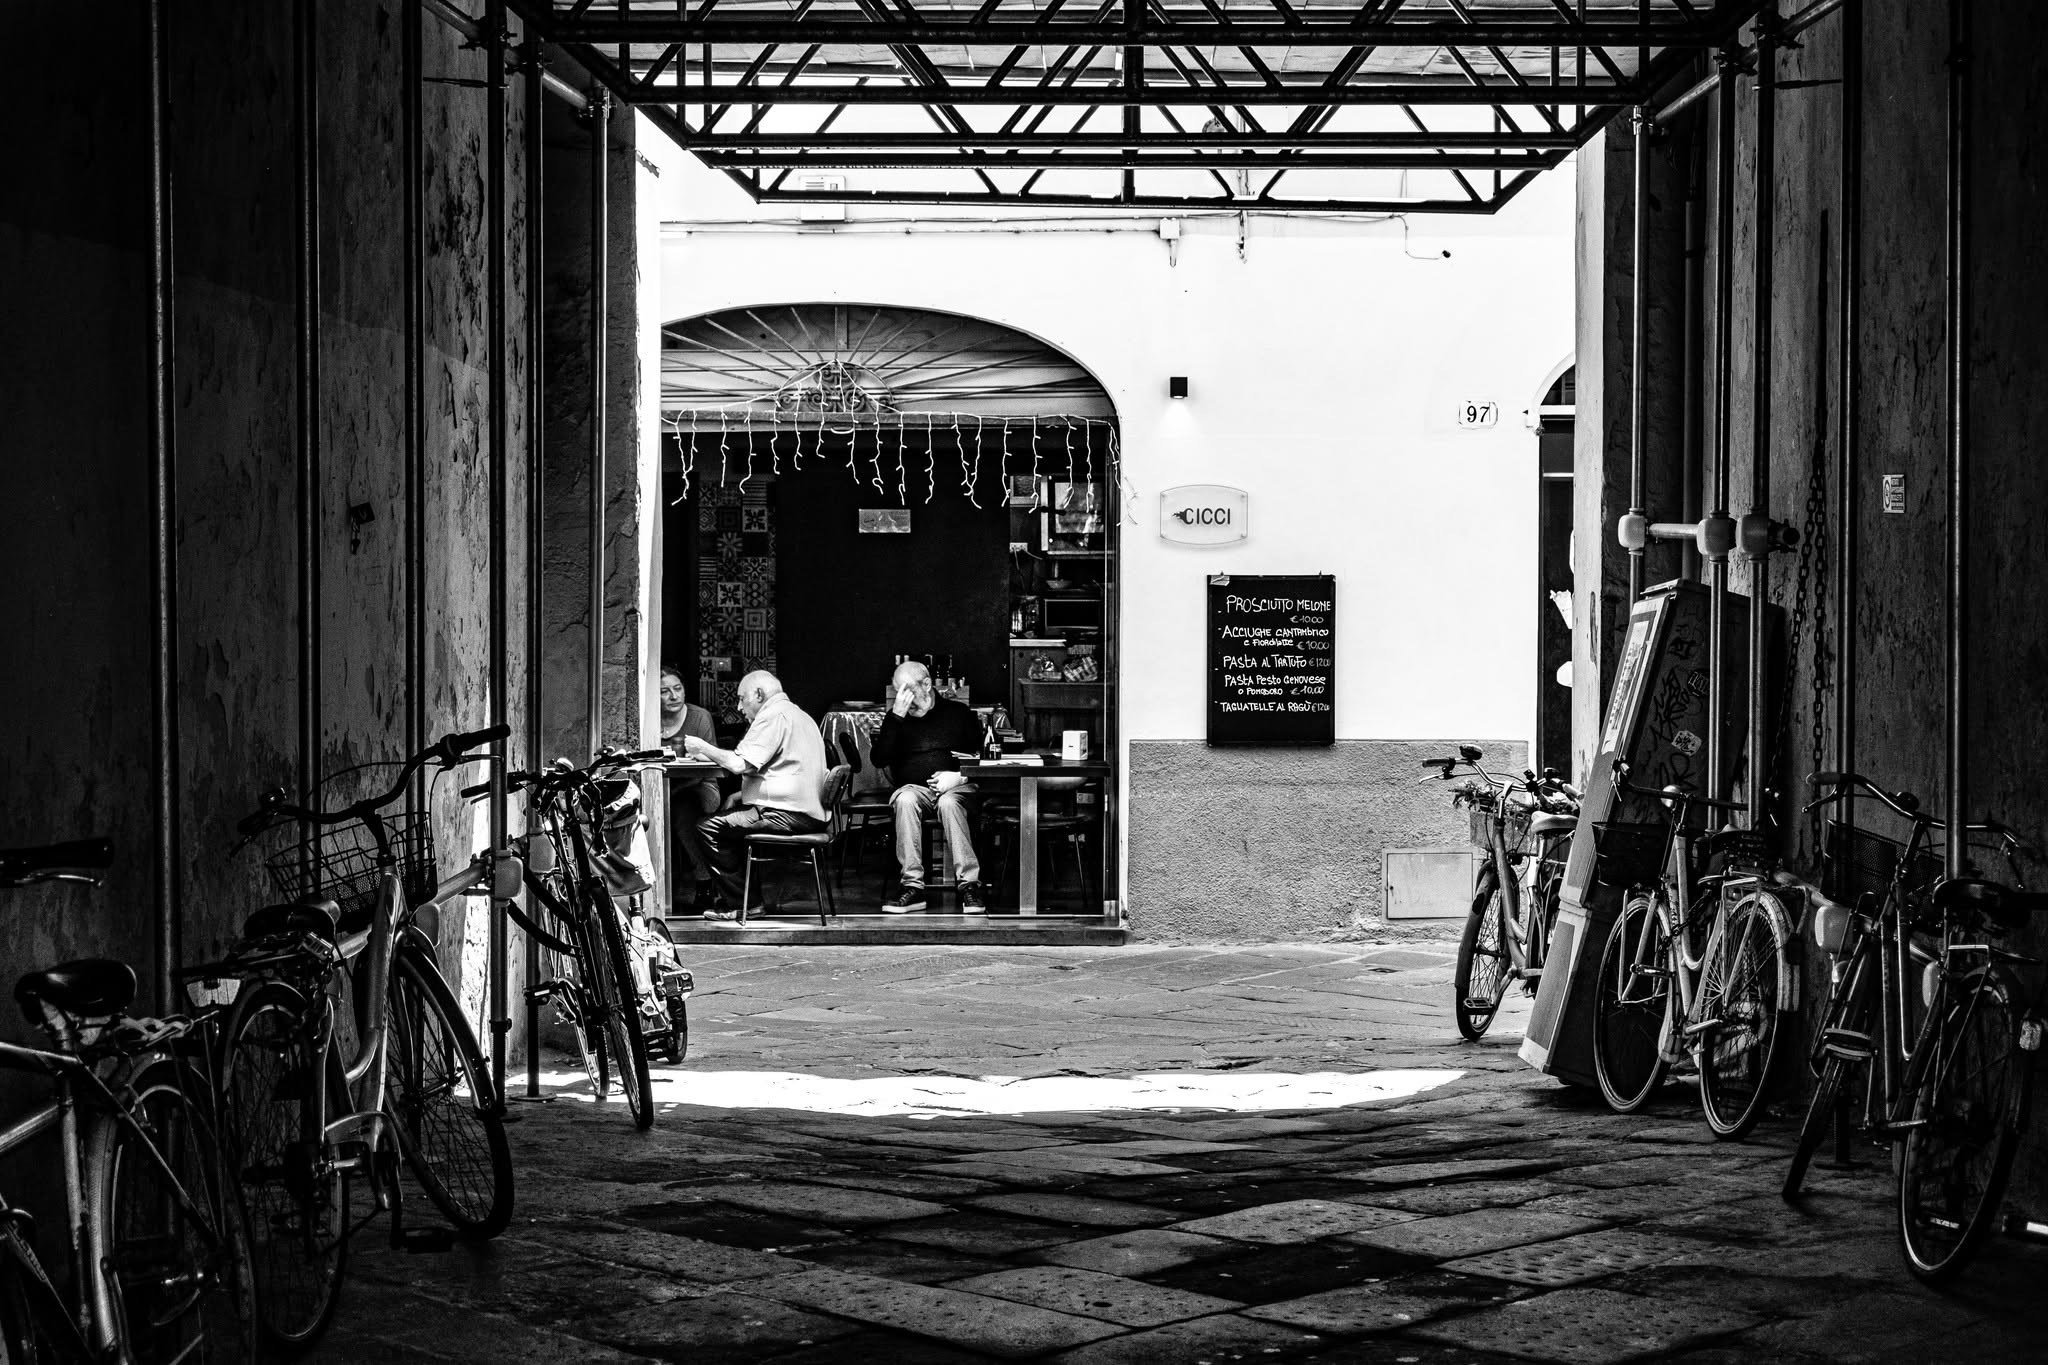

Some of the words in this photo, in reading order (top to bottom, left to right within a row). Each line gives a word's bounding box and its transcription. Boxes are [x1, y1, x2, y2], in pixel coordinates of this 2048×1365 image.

[1467, 405, 1490, 423] 97
[1183, 507, 1231, 525] CICCI
[1226, 594, 1294, 613] PROSCIUTTO
[1296, 599, 1331, 612] MELONE
[1222, 625, 1272, 639] ACCIUGHE
[1256, 674, 1281, 685] Pesto
[1246, 687, 1283, 696] POMODORO
